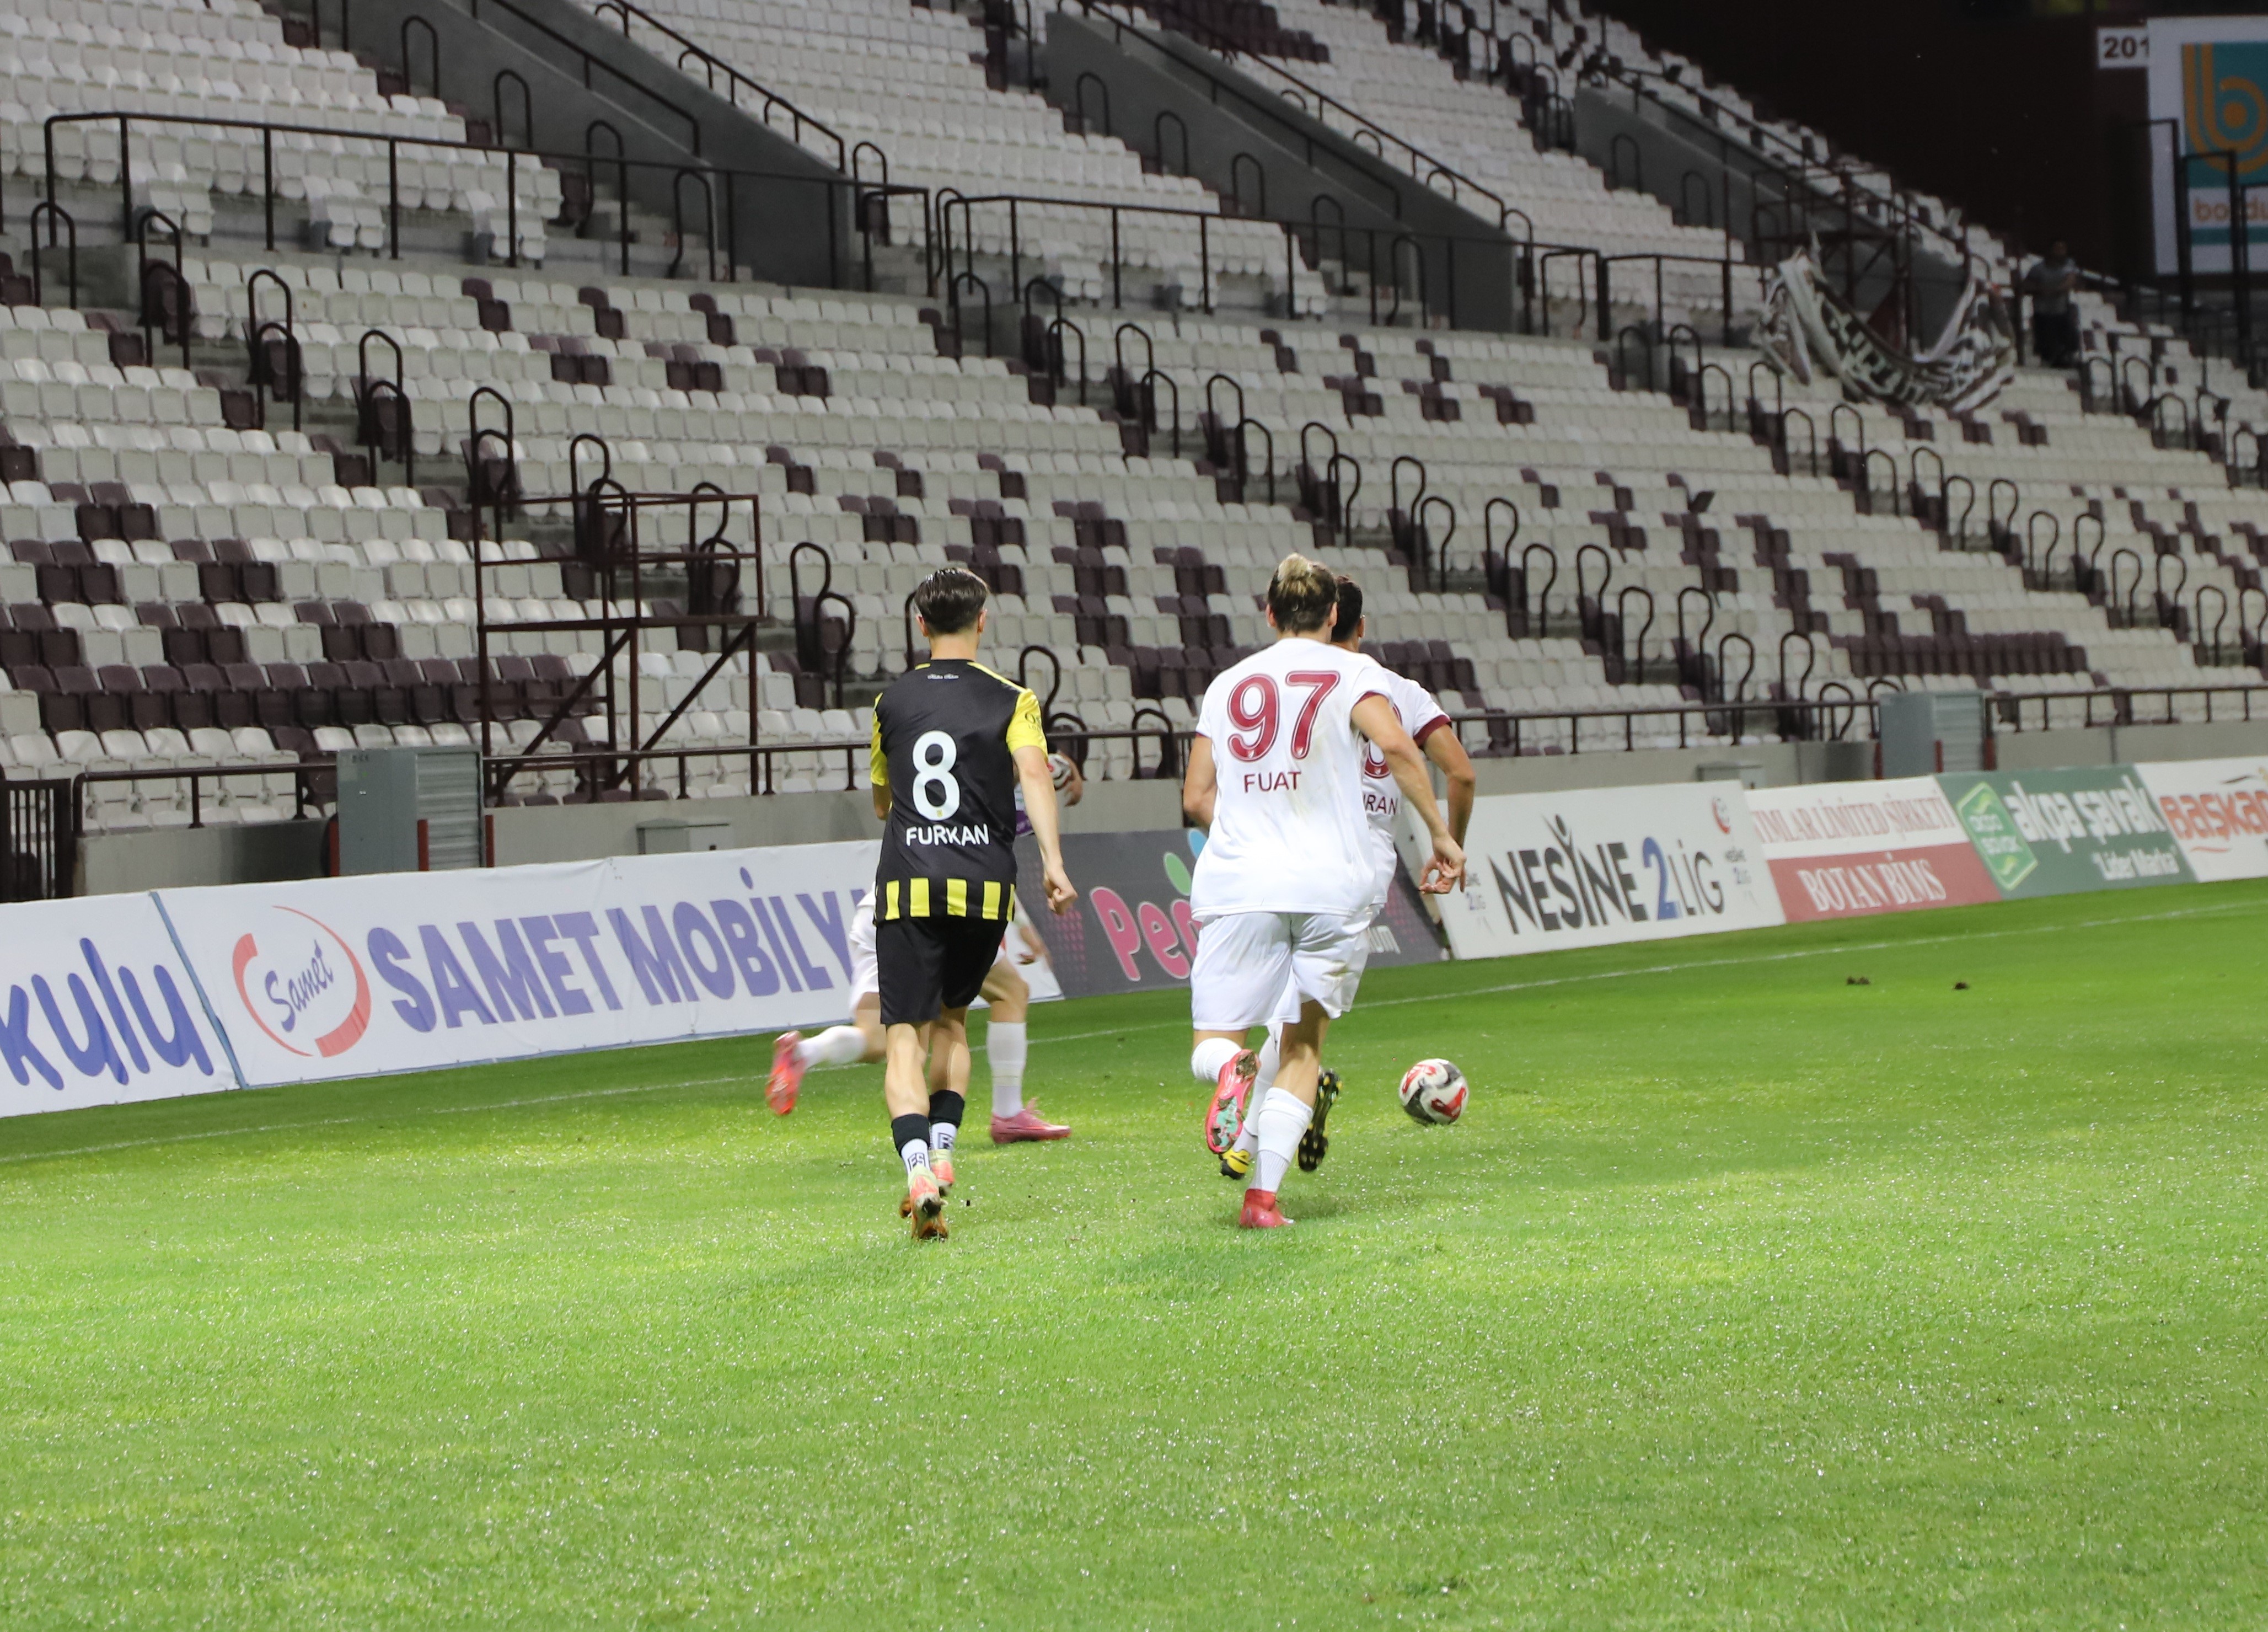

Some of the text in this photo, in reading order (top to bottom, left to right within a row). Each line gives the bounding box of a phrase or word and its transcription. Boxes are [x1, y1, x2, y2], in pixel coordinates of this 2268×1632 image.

[1227, 670, 1341, 763] 97
[912, 730, 961, 821] 8
[1243, 771, 1302, 793] FUAT
[2004, 780, 2088, 853] akpa
[906, 824, 990, 846] FURKAN
[1797, 851, 1947, 912] BOTAN BİMS
[265, 939, 334, 1033] Samet
[367, 866, 867, 1033] SAMET MOBİLY
